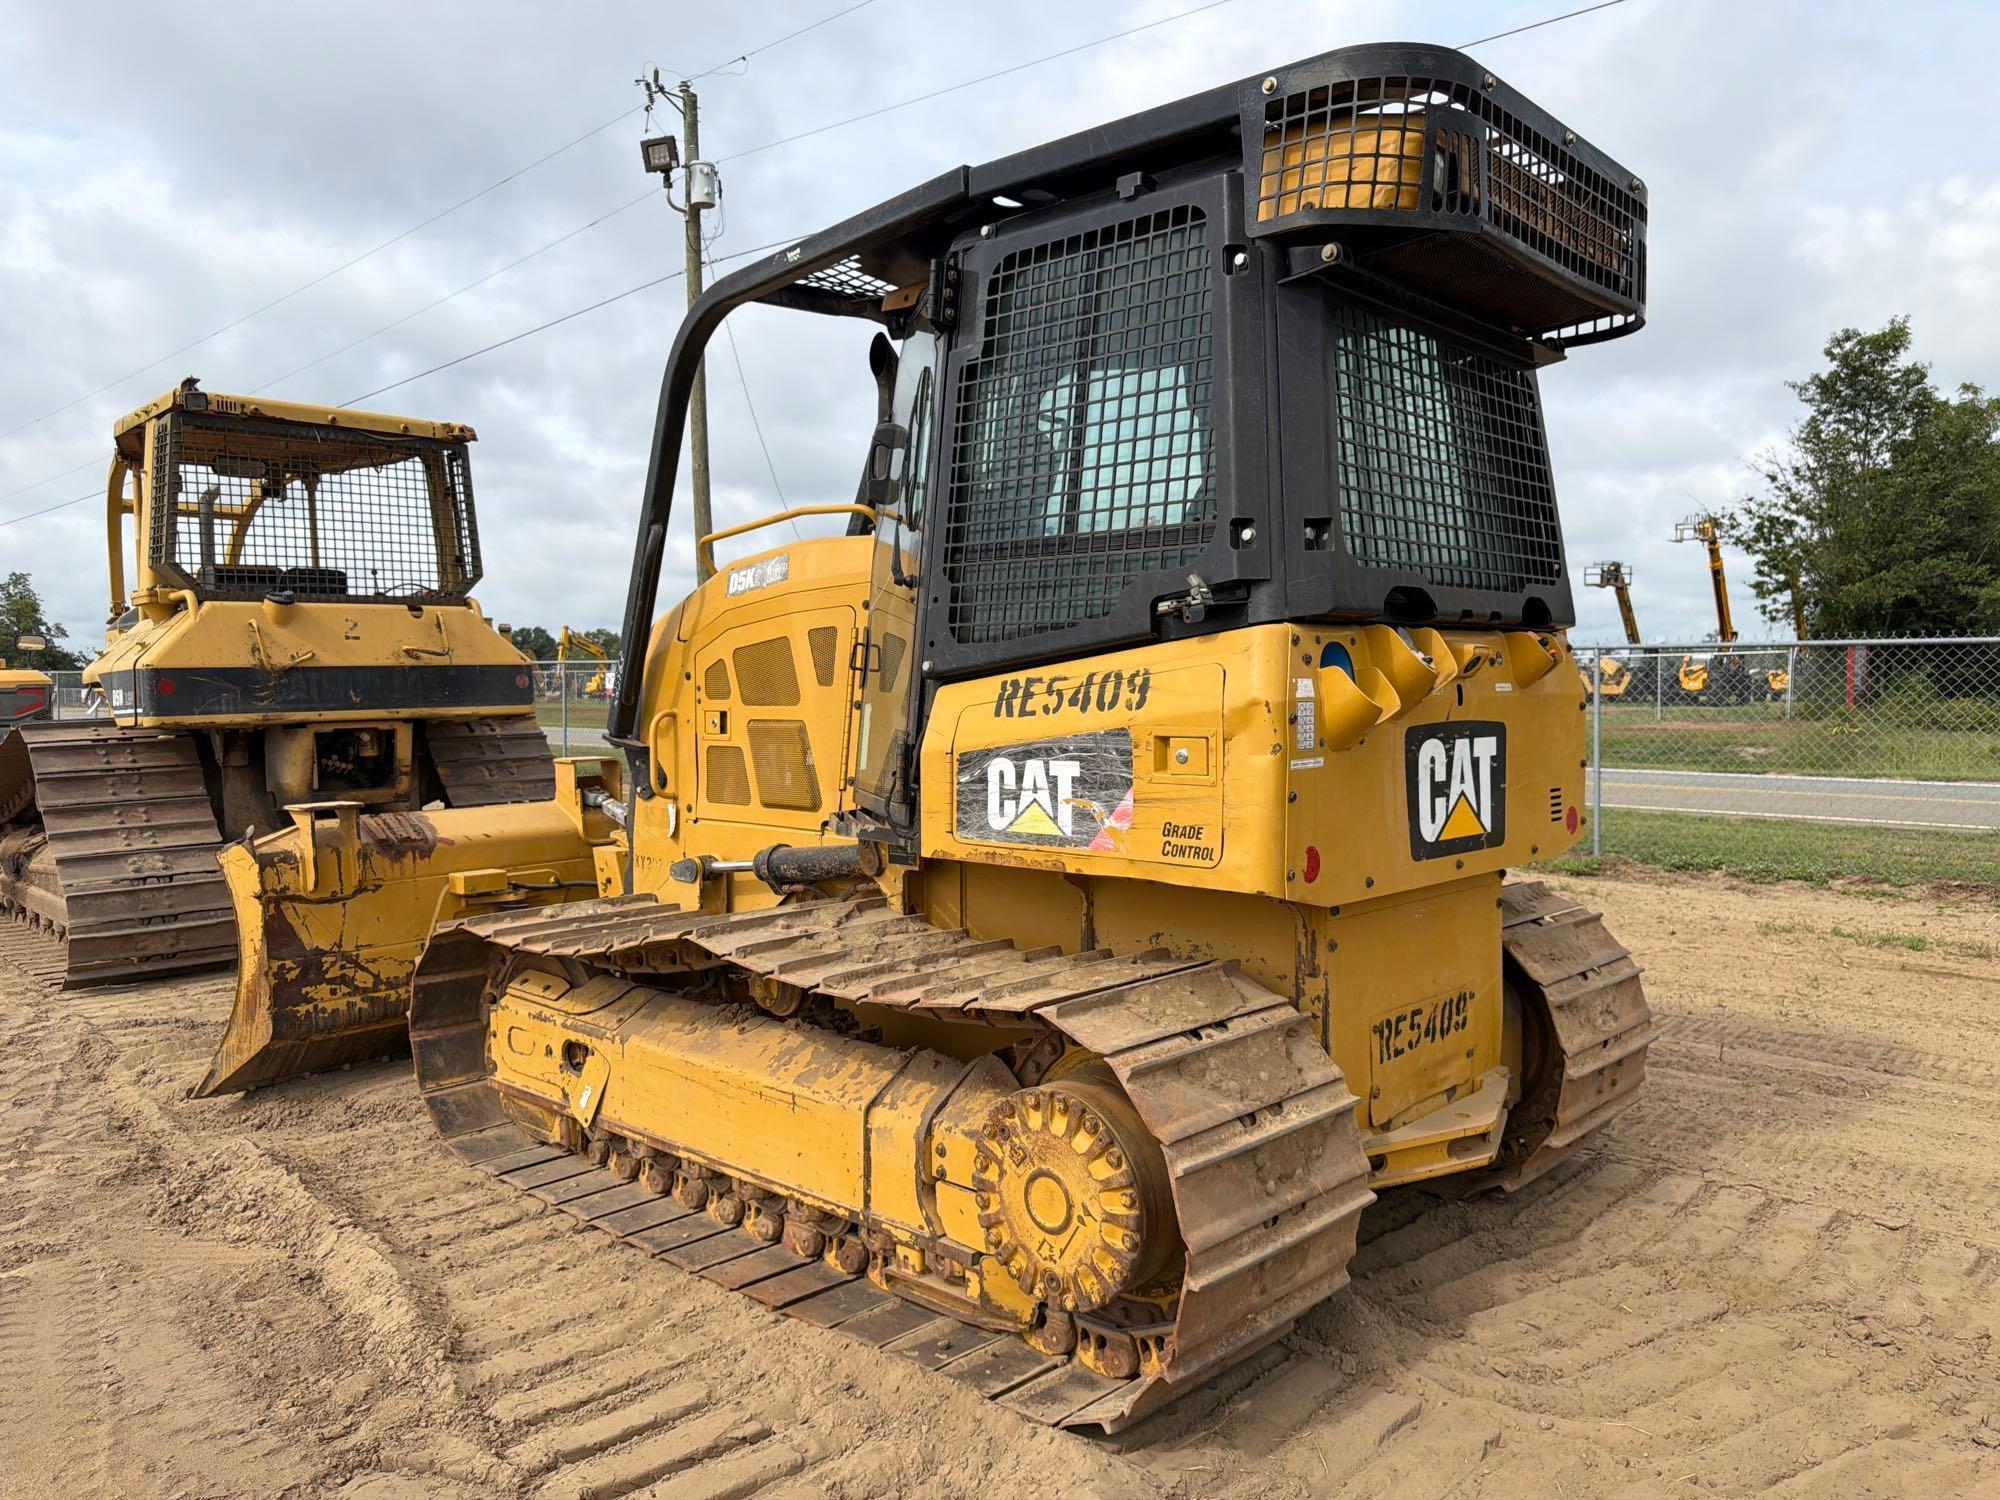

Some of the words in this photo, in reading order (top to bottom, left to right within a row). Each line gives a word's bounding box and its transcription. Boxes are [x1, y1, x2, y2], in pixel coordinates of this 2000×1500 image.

[994, 668, 1150, 718] RE5409
[987, 757, 1081, 836] CAT
[1418, 736, 1497, 842] CAT
[1378, 990, 1468, 1065] RE5409
